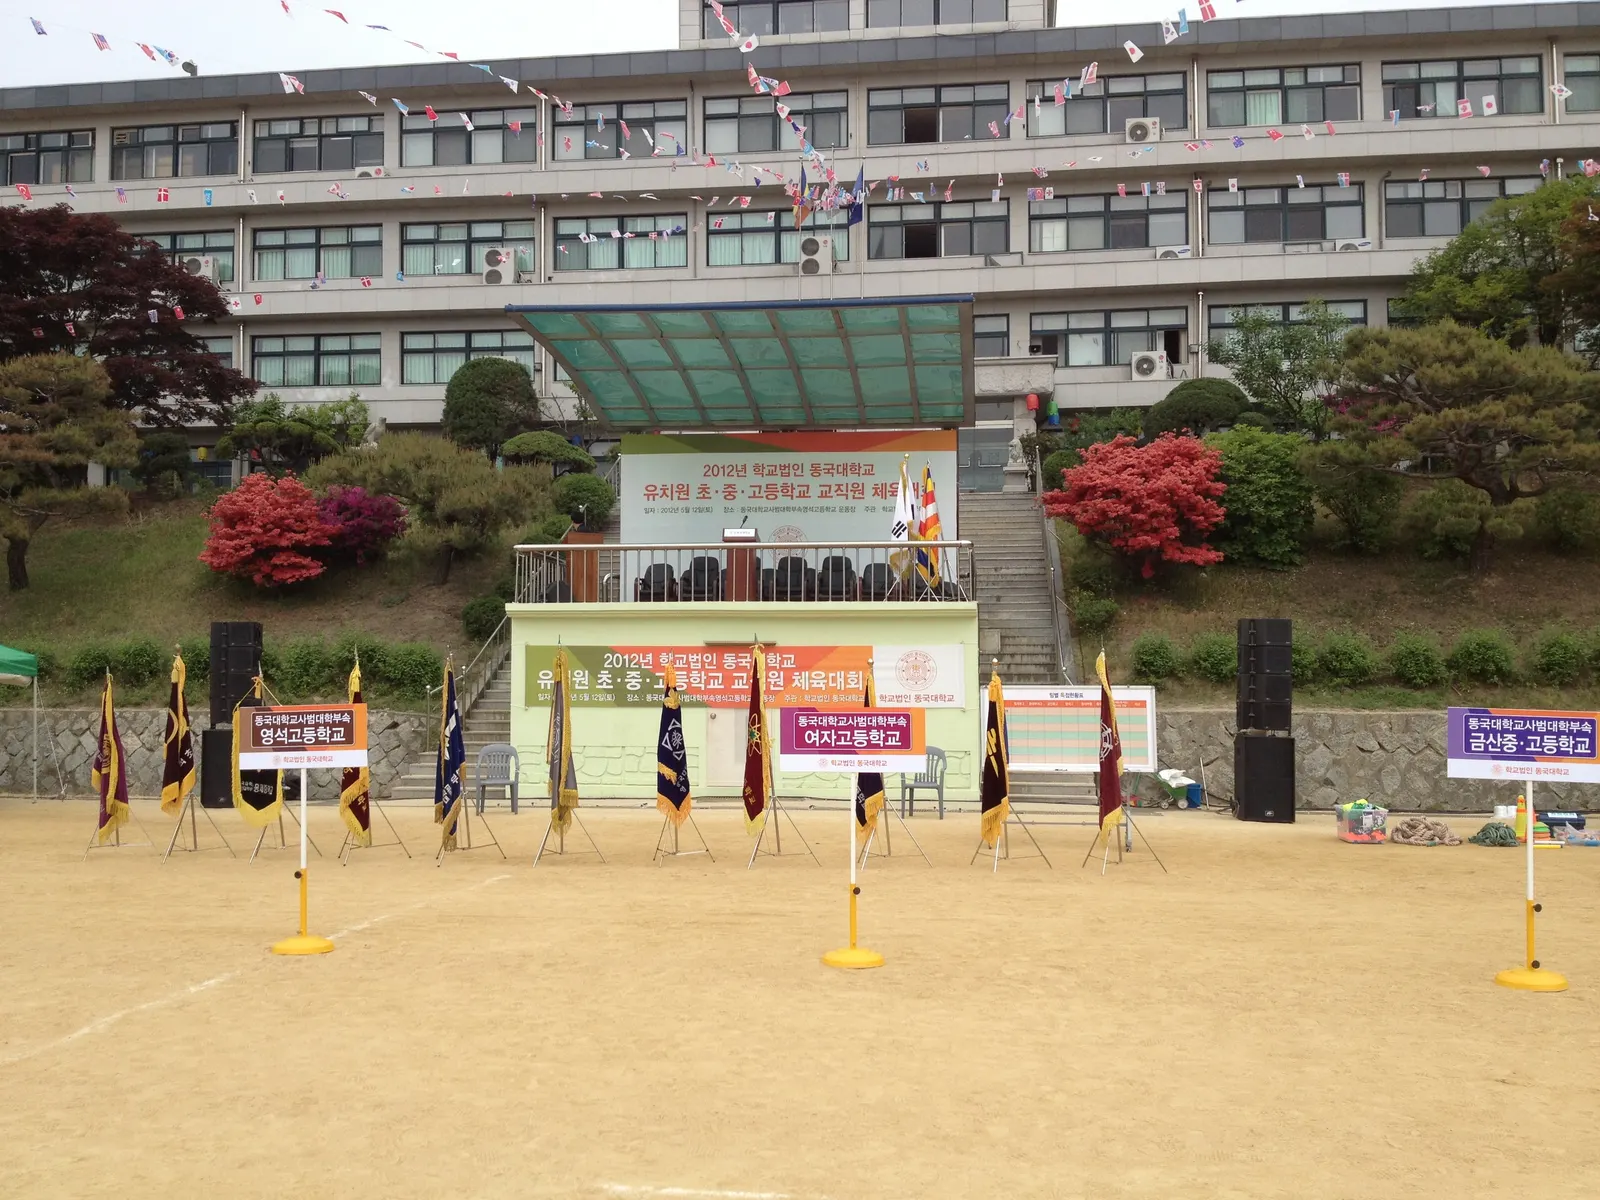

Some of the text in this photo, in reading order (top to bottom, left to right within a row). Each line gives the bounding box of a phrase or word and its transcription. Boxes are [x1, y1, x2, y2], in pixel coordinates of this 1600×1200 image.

[703, 462, 875, 478] 2012년 학교법인 동국대학교
[643, 483, 690, 501] 유치원
[817, 482, 865, 500] 교직원
[603, 653, 796, 669] 2012년 학교법인 동국학교
[537, 670, 589, 690] 유원
[731, 671, 784, 690] 교원
[792, 671, 863, 690] 체육대회
[879, 694, 955, 703] 학교법인 동국대학교
[254, 713, 351, 727] 동국대학교사범대학부속
[797, 715, 907, 727] 동국대학교사범대학부속
[1467, 717, 1593, 734] 동국대학교사범대학부속
[260, 726, 346, 745] 영석고등학교
[804, 729, 902, 747] 여자고등학교
[1469, 732, 1592, 755] 금산중·고등학교
[831, 759, 888, 767] 학교법인 동국대학교
[1505, 766, 1570, 775] 학교법인 동국대학교
